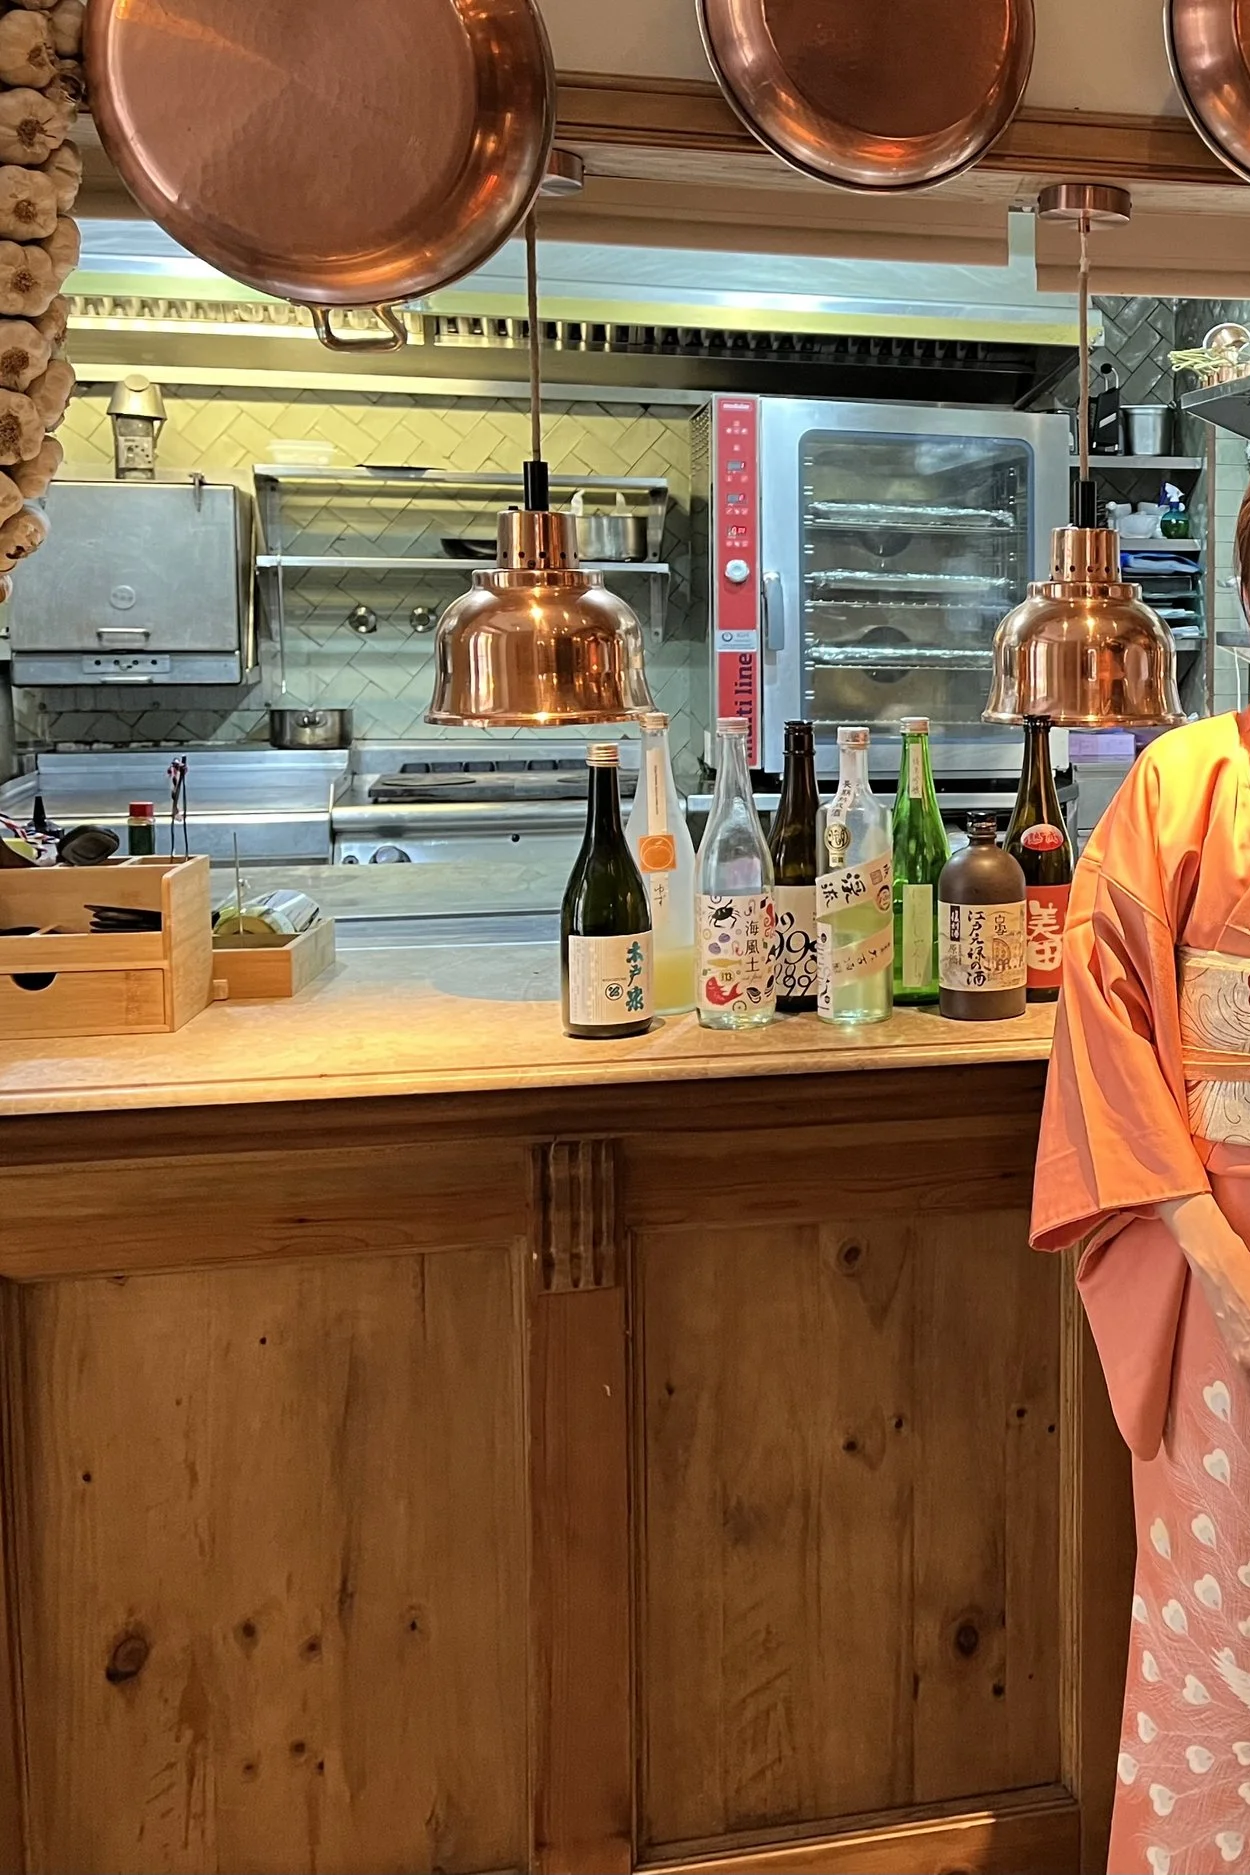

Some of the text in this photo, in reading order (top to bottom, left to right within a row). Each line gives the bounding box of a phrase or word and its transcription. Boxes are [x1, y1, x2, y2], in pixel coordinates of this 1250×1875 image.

[745, 920, 760, 972] 海風土
[967, 910, 987, 987] 江戸元禄の酒
